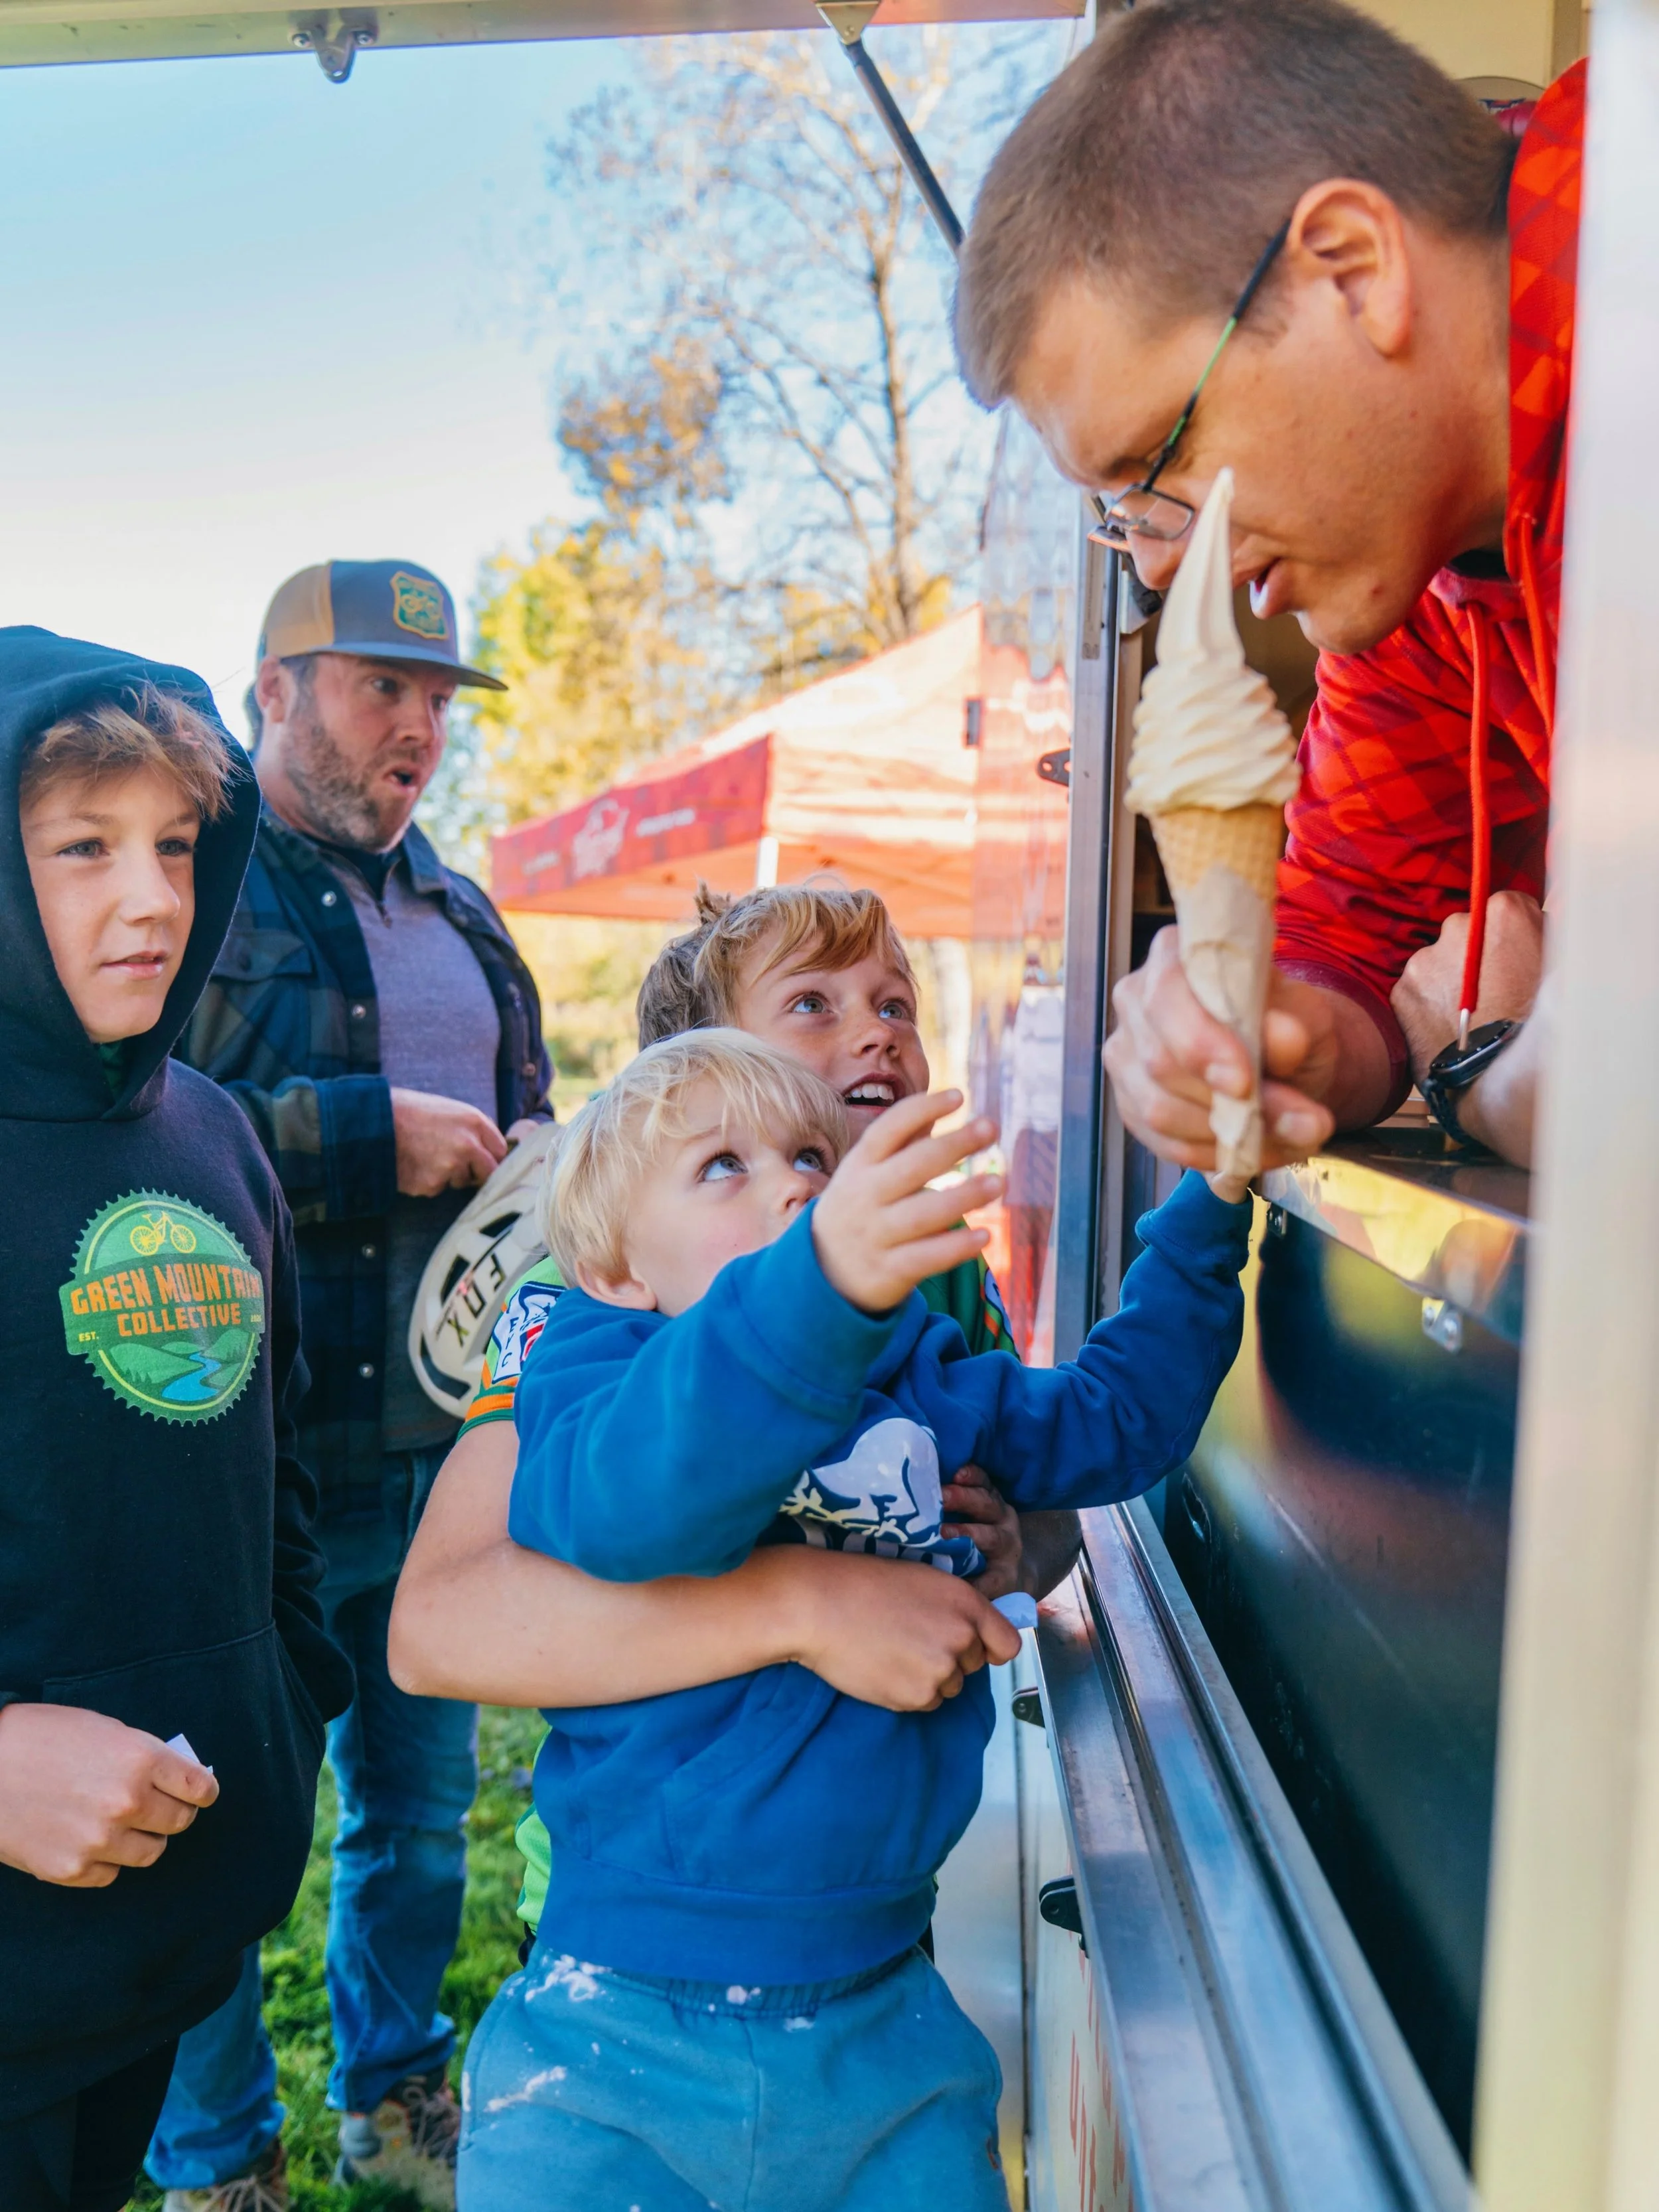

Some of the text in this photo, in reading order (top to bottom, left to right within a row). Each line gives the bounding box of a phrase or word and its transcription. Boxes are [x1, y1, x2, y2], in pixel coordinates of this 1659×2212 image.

[70, 1264, 260, 1315] GREEN MOUNTAIN
[447, 1252, 506, 1348] FOX
[78, 1331, 100, 1342] EST.
[117, 1303, 241, 1337] COLLECTIVE
